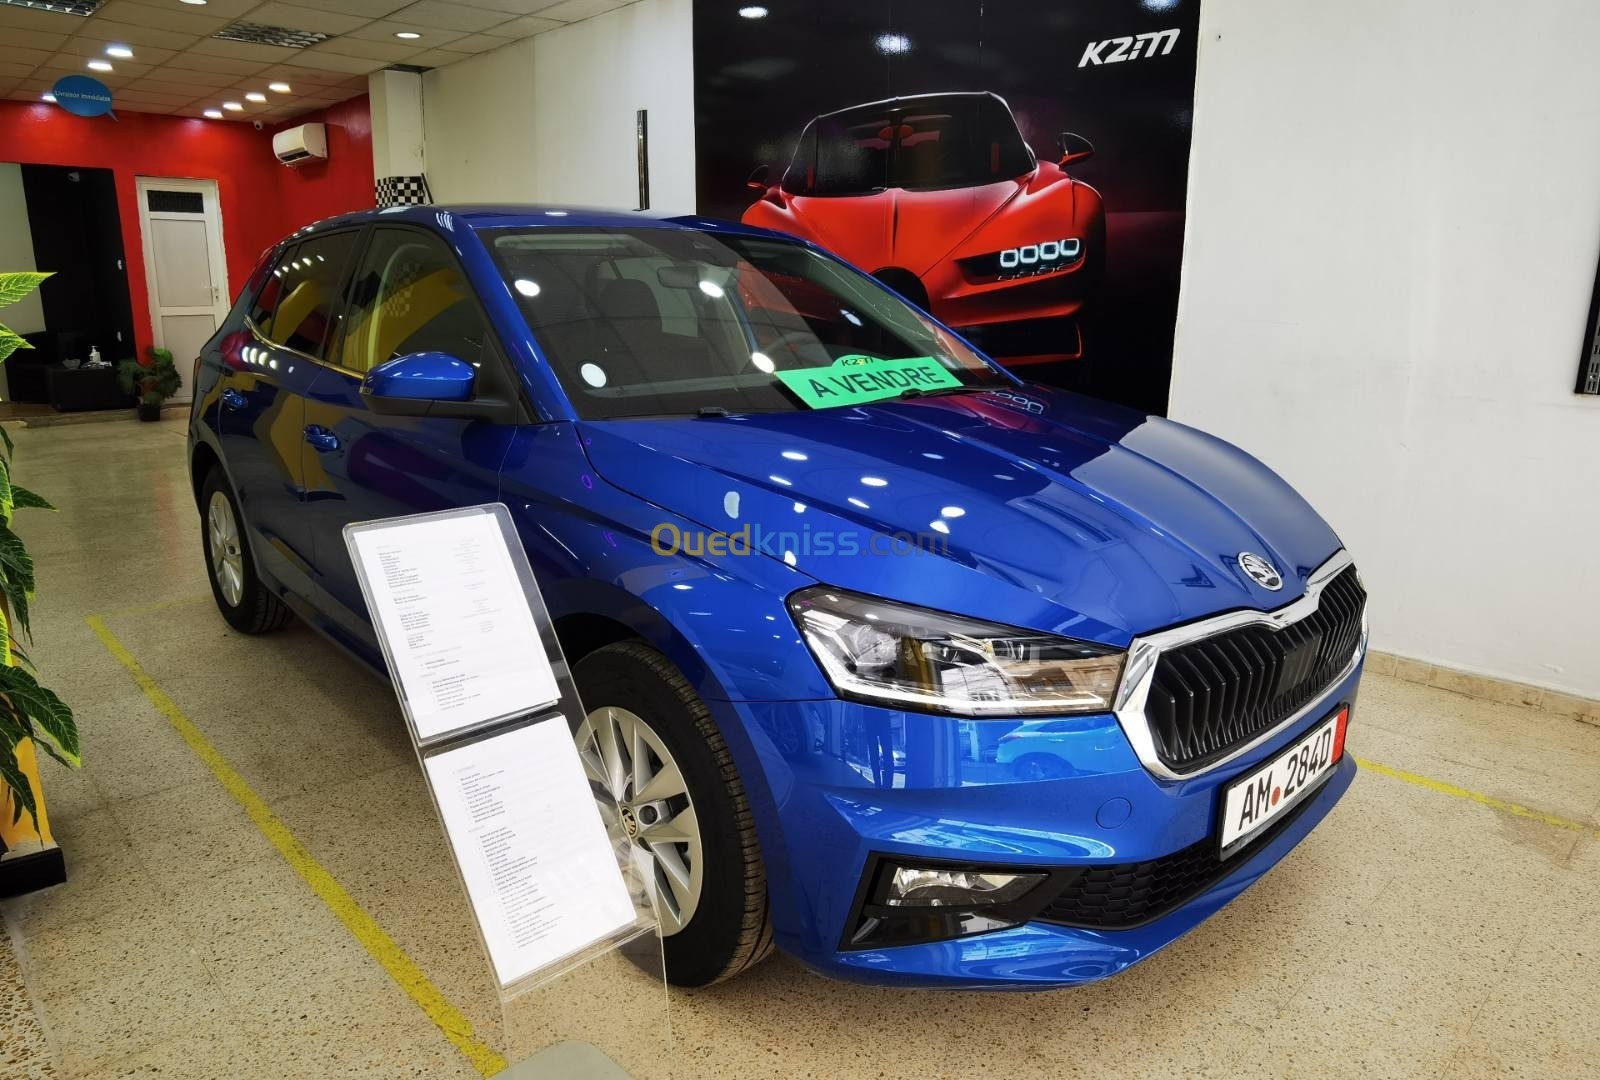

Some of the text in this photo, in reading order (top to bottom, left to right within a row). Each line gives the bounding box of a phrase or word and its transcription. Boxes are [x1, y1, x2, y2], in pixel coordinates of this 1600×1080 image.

[808, 366, 945, 398] A VENDRE
[1238, 771, 1273, 831] AM
